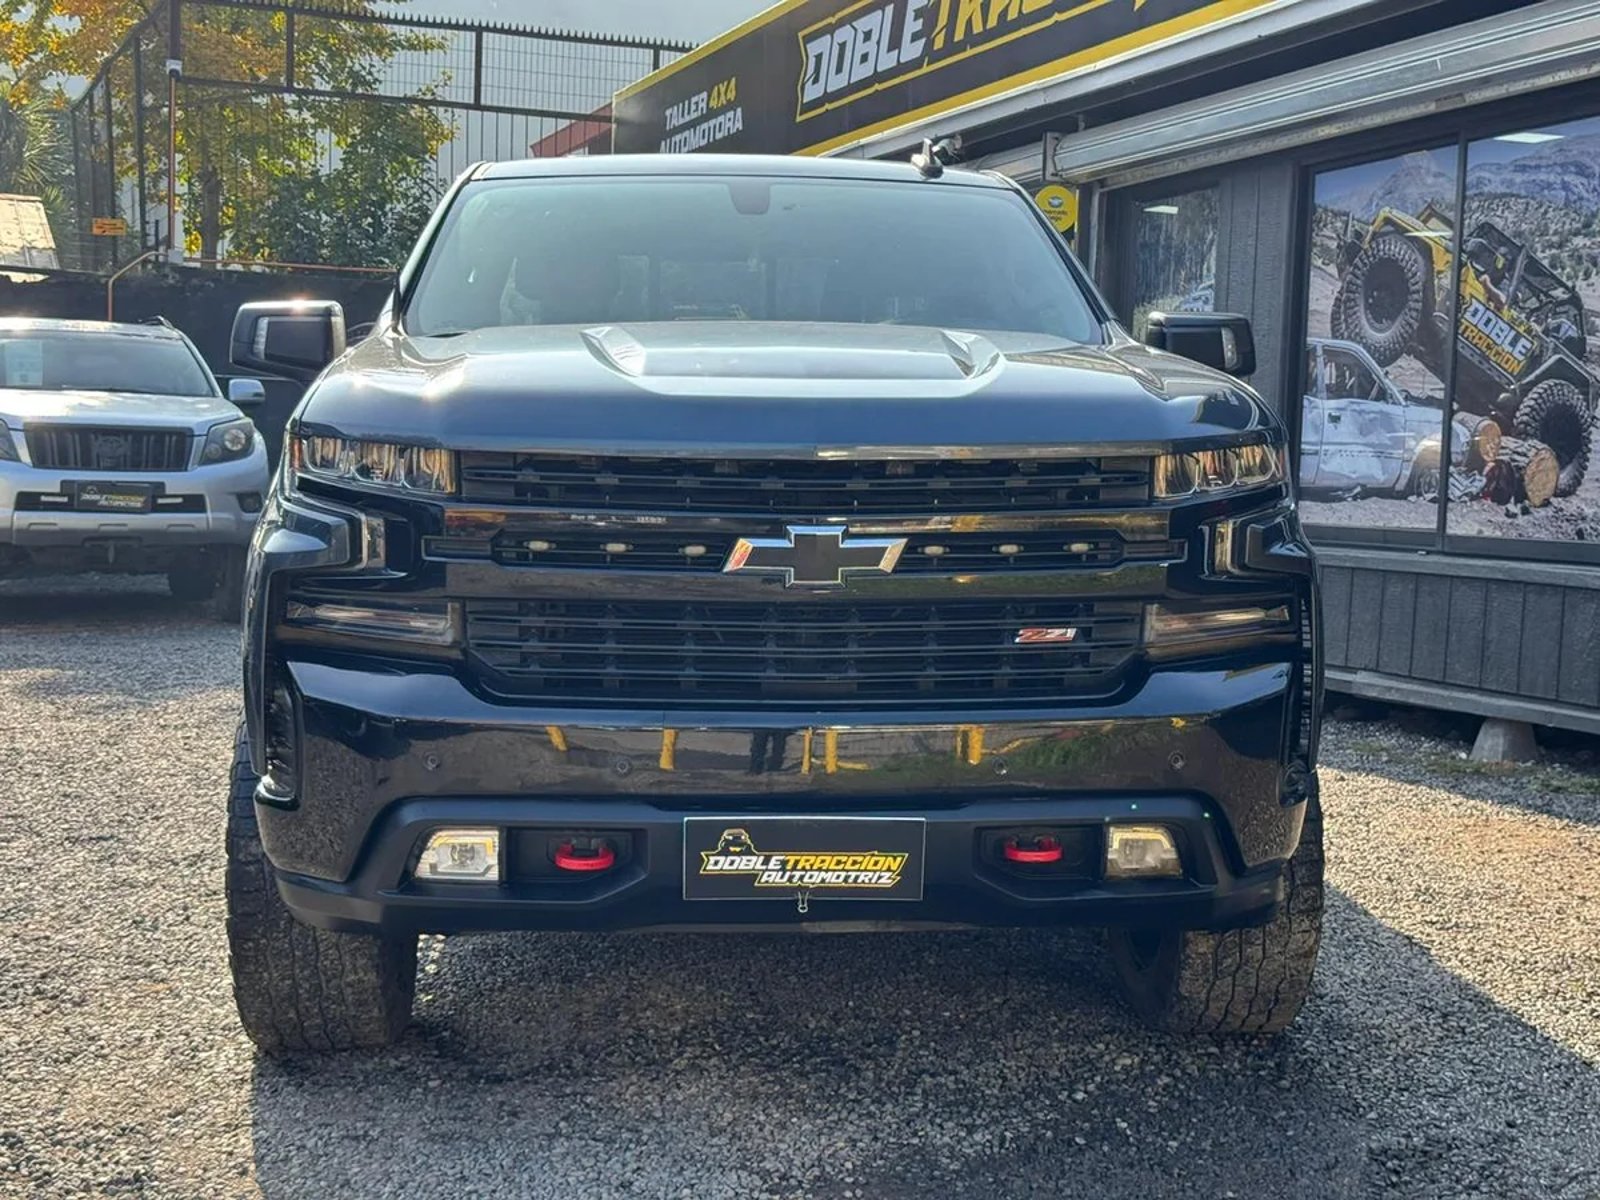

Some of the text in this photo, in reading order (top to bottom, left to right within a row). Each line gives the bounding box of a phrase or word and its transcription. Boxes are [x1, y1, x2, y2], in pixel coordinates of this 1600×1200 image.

[665, 76, 737, 131] TALLER 4X4
[659, 106, 743, 153] AUTOMOTORA
[1463, 298, 1533, 362] DOBLE
[1014, 626, 1077, 643] Z71
[759, 870, 895, 884] AUTOMOTRIZ
